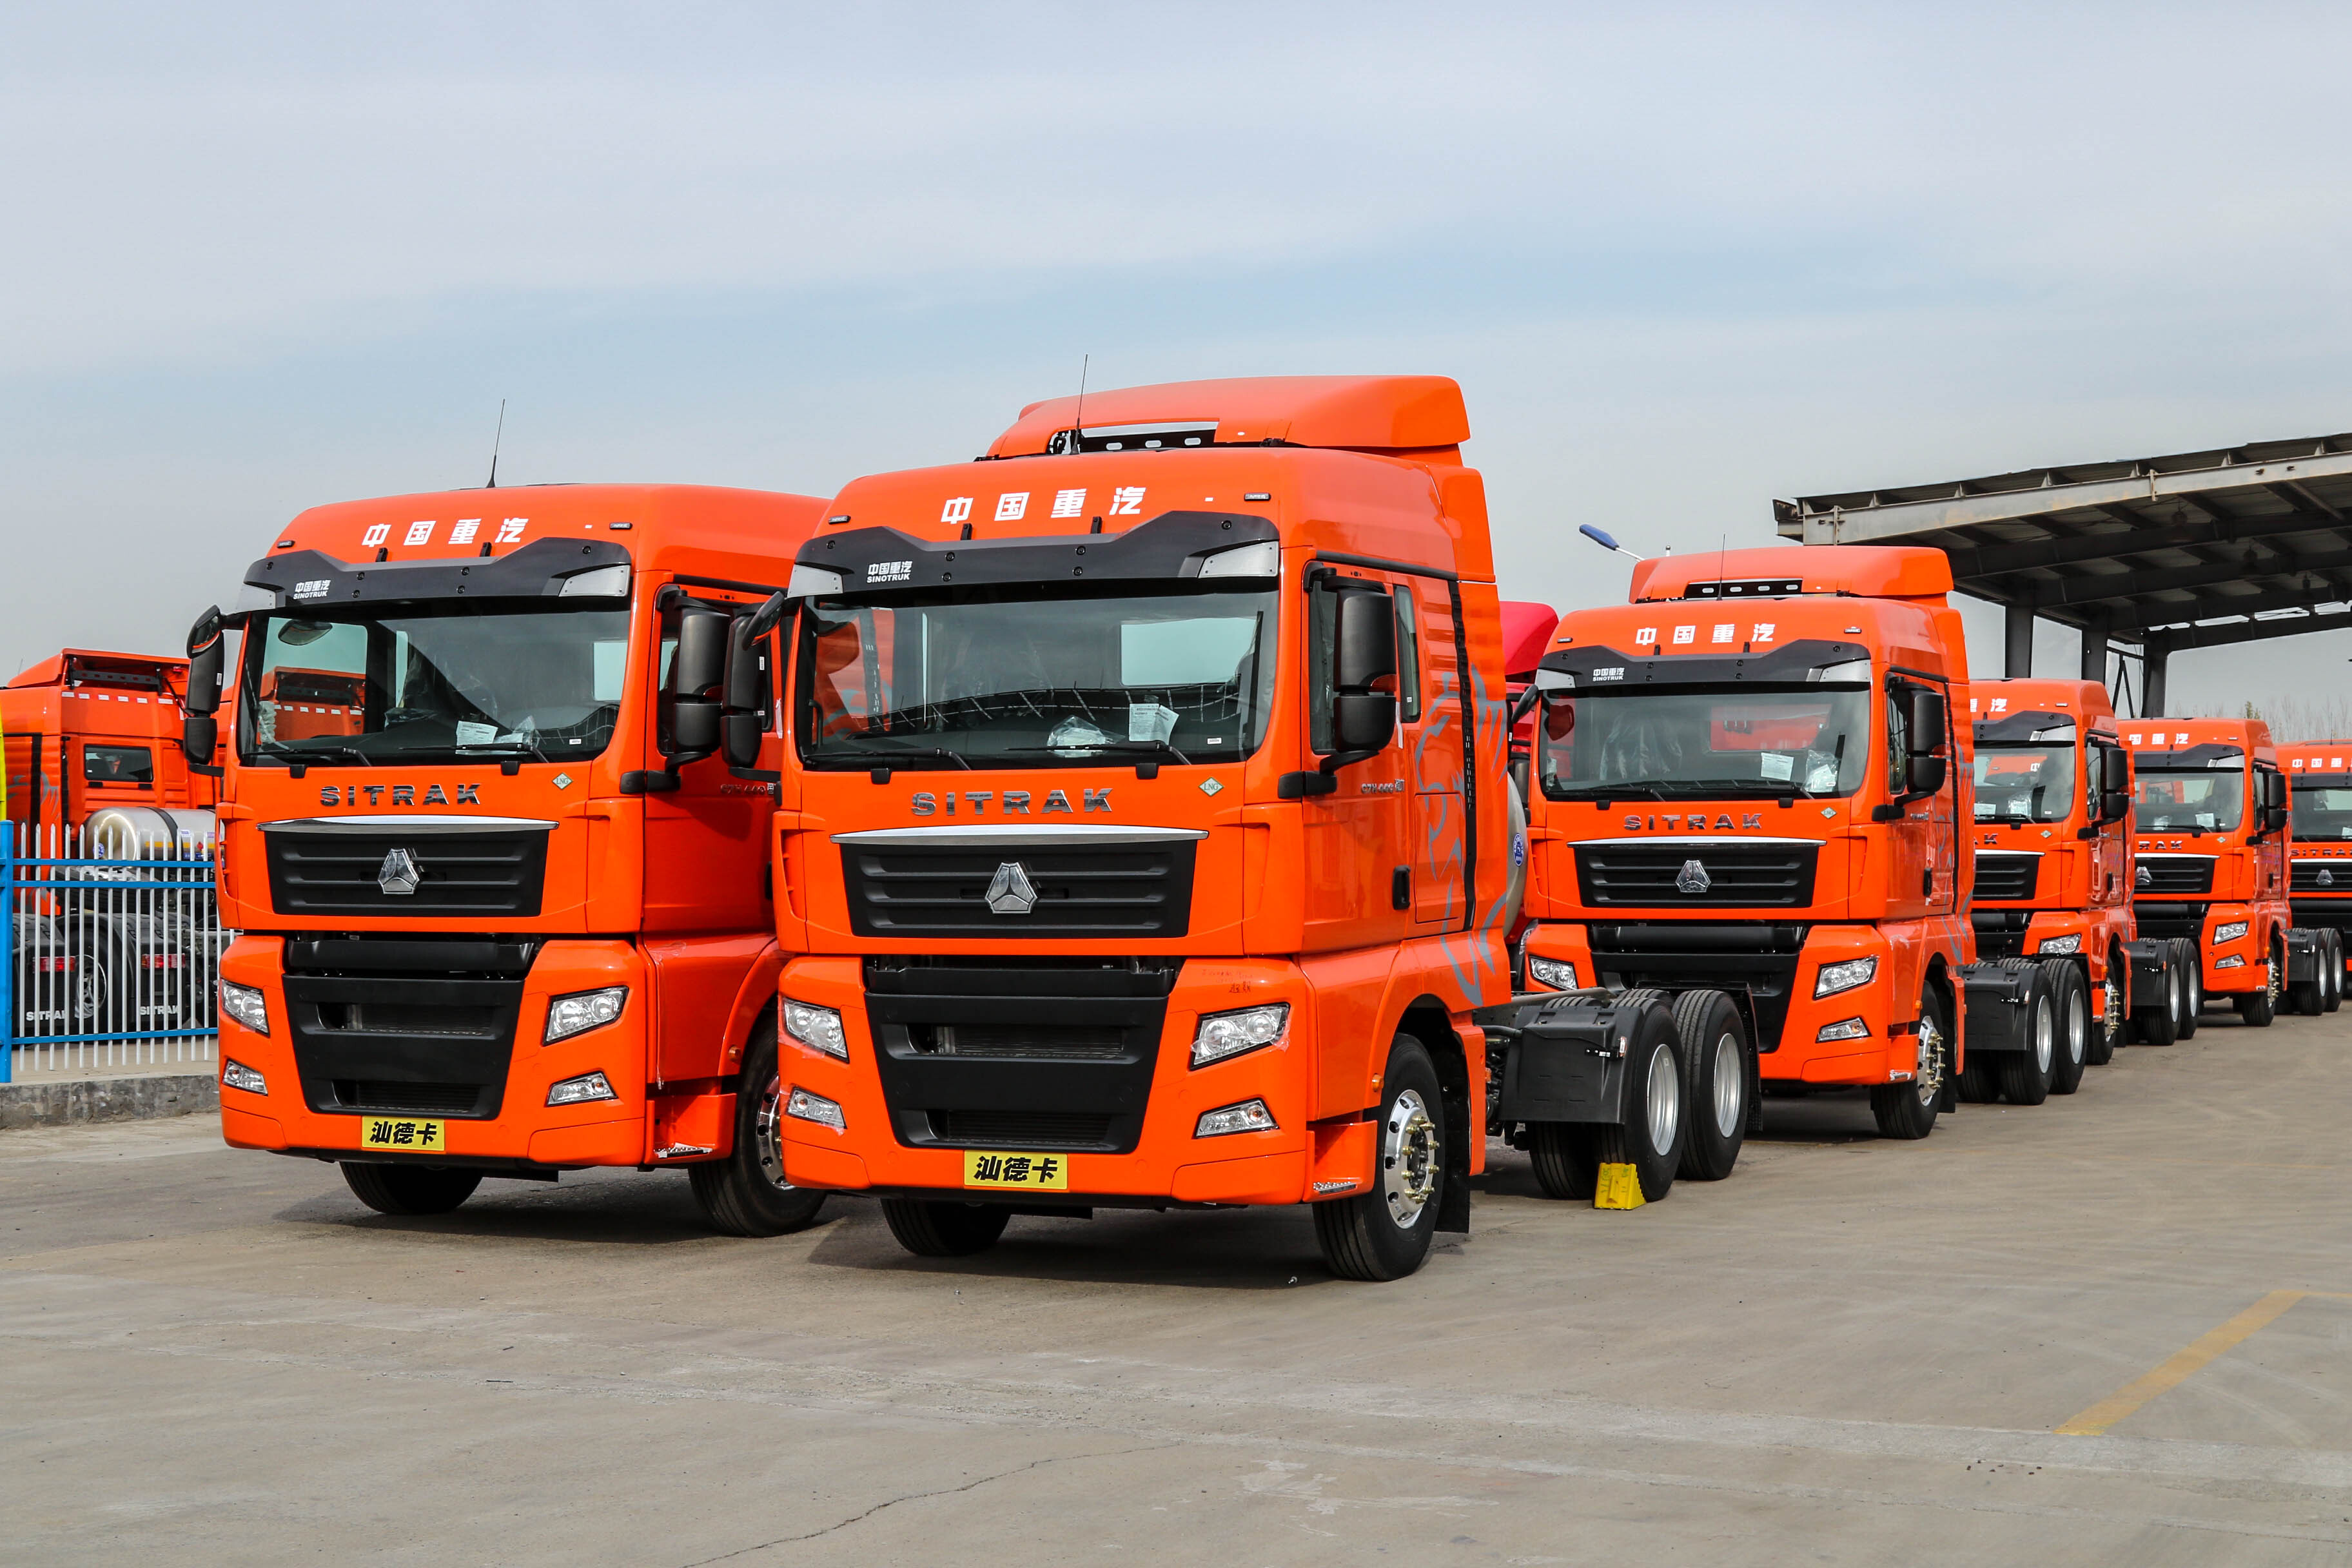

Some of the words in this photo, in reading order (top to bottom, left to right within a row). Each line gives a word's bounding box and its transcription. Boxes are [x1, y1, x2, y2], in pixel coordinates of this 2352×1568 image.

[941, 486, 1146, 525] 中国重汽
[362, 517, 529, 547] 中国重汽
[868, 560, 913, 575] 中国重汽
[867, 573, 911, 583] SINOTRUK
[295, 579, 331, 593] 中国重汽
[293, 590, 328, 600] SINOTRUK
[1635, 623, 1776, 645] 中国重汽
[1592, 667, 1625, 676] 中国重汽
[2291, 758, 2352, 769] 中国重
[320, 783, 481, 807] SITRAK
[911, 788, 1113, 816] SITRAK
[1623, 813, 1763, 831] SITRAK
[2138, 840, 2183, 850] RAK
[2290, 848, 2352, 857] SITRA
[26, 1010, 68, 1021] STRA
[369, 1121, 437, 1145] 汕德卡
[974, 1156, 1058, 1183] 汕德卡
